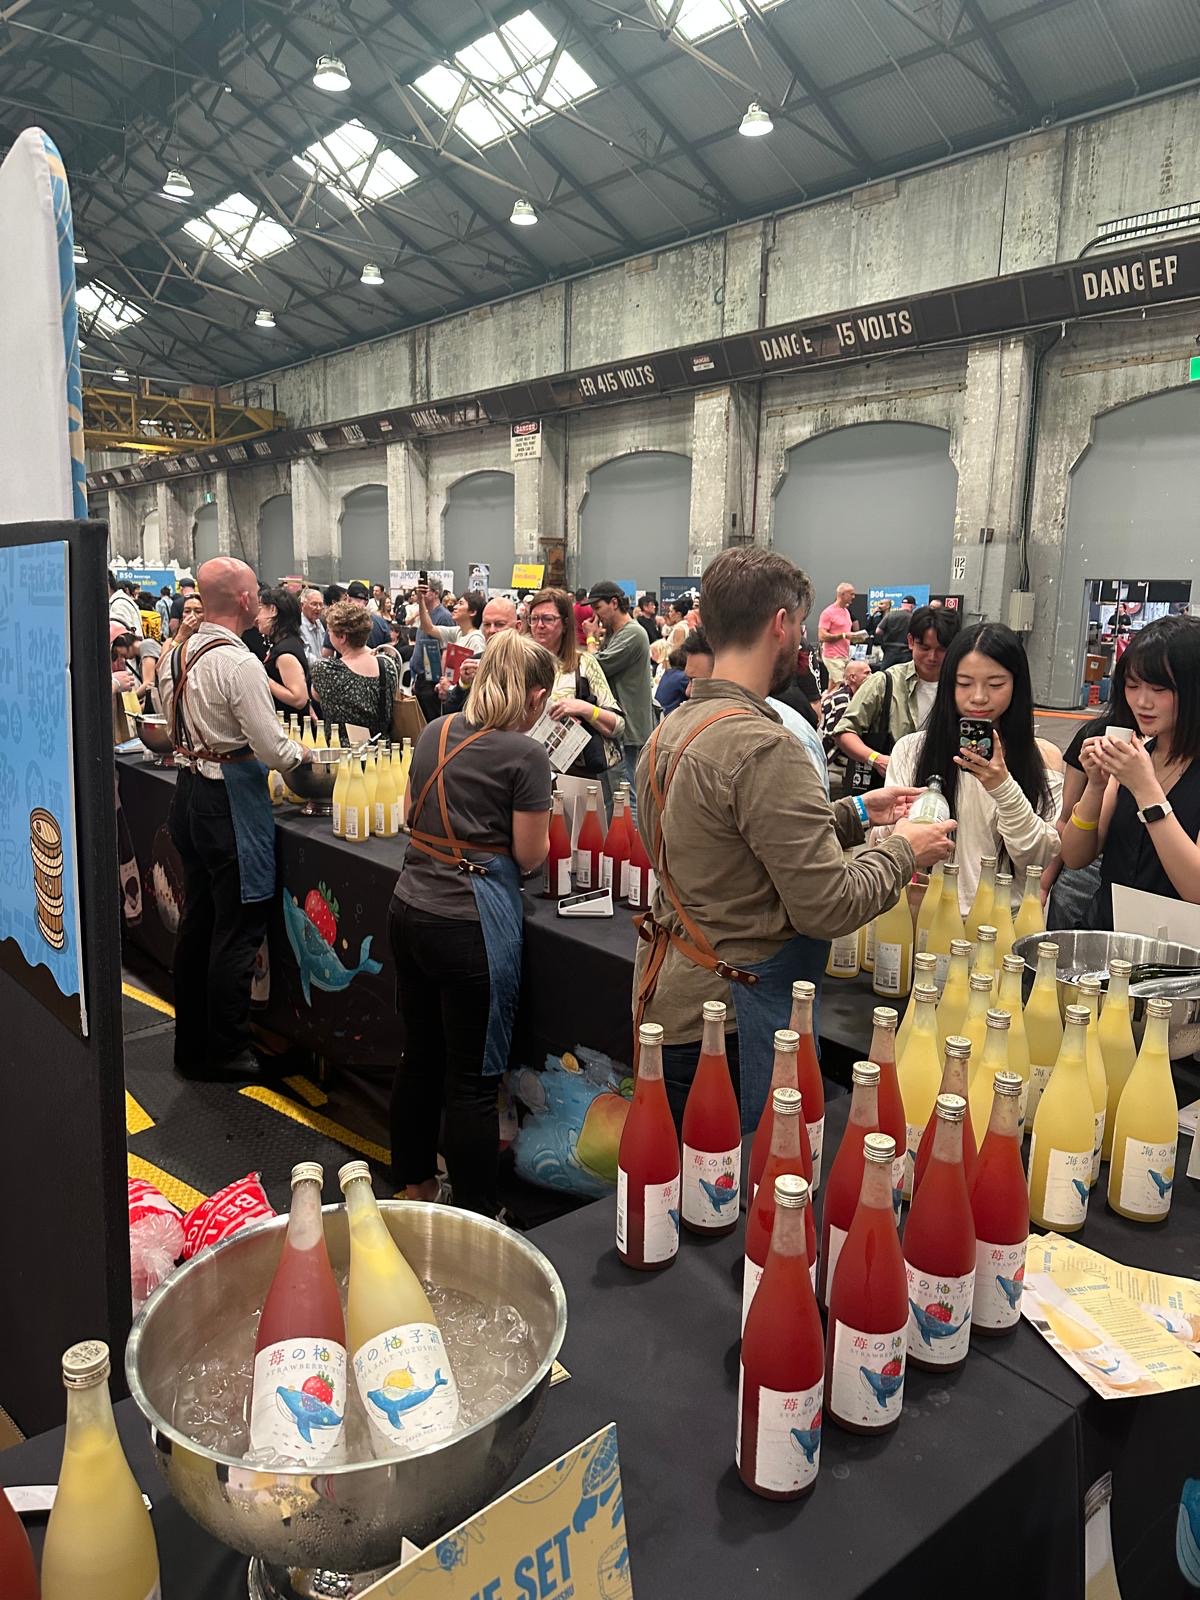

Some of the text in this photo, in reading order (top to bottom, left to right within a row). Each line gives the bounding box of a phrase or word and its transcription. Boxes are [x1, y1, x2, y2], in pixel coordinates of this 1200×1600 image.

[759, 310, 913, 362] DANGE 15 VOLTS
[597, 372, 618, 393] 415
[617, 365, 655, 389] VOLTS
[870, 590, 884, 598] B06
[514, 1525, 571, 1600] SET
